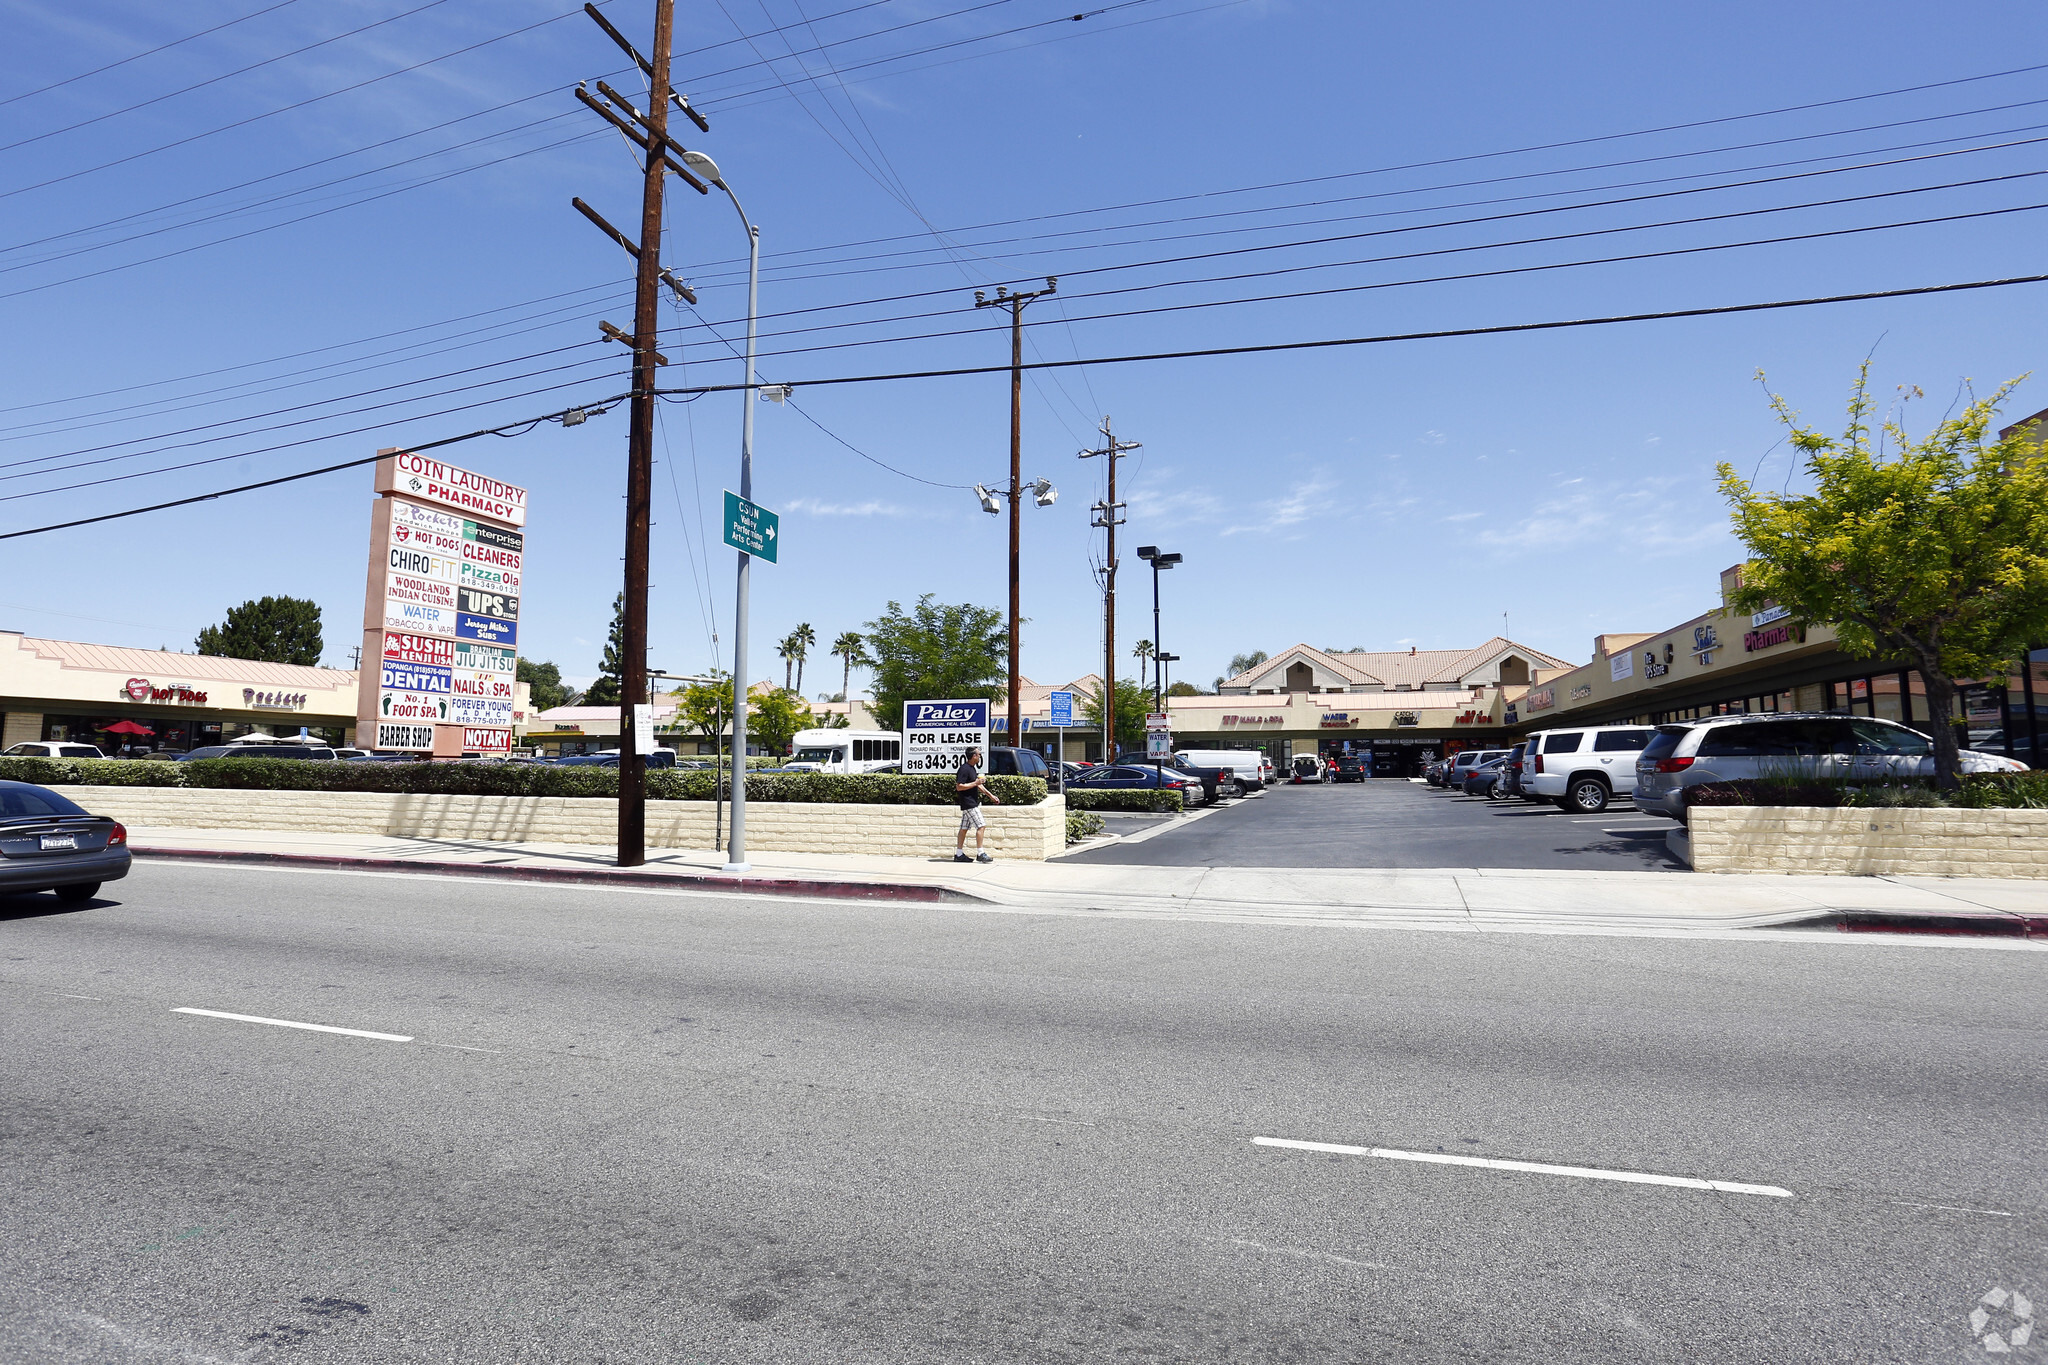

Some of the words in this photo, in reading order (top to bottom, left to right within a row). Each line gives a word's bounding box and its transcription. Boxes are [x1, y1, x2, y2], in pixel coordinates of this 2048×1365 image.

[399, 453, 443, 480] COIN
[450, 468, 524, 504] LAUNDRY
[428, 484, 514, 518] PHARMACY
[739, 502, 759, 519] CSUN
[740, 515, 757, 530] Valley
[415, 530, 432, 544] HOT
[436, 536, 460, 550] DOGS
[466, 526, 522, 546] enterprise
[732, 531, 744, 544] Arts
[746, 538, 764, 551] Center
[734, 522, 763, 543] Performing
[390, 548, 456, 578] CHIROFIT
[464, 544, 520, 568] CLEANERS
[462, 562, 501, 582] Pizza
[502, 572, 518, 586] Ola
[396, 576, 450, 596] WOODLANDS
[460, 577, 518, 595] 818-349-0133
[388, 586, 420, 600] INDIAN
[422, 593, 454, 607] CUISINE
[468, 590, 504, 616] UPS
[404, 604, 440, 621] WATER
[386, 616, 424, 630] TOBACCO
[428, 624, 434, 632] &
[438, 624, 454, 634] VAPE
[464, 618, 488, 632] Jersey
[401, 635, 453, 656] SUSHI
[470, 645, 502, 656] BRAZILIAN
[384, 662, 413, 672] TOPANGA
[401, 651, 432, 663] KENJI
[434, 656, 452, 666] USA
[457, 652, 476, 668] JIU
[480, 656, 514, 672] JITSU
[382, 670, 450, 692] DENTAL
[454, 679, 484, 695] NAILS
[486, 687, 492, 695] &
[493, 682, 510, 697] SPA
[152, 688, 174, 700] HOT
[179, 690, 208, 702] DOGS
[392, 704, 418, 717] FOOT
[420, 706, 437, 718] SPA
[452, 698, 486, 710] FOREVER
[488, 701, 512, 712] YOUNG
[917, 705, 976, 722] Paley
[456, 716, 506, 724] 818-775-0377
[380, 726, 410, 747] BARBER
[412, 727, 432, 748] SHOP
[466, 729, 510, 746] NOTARY
[910, 734, 935, 743] FOR
[941, 733, 981, 743] LEASE
[907, 760, 923, 769] 818
[925, 755, 983, 769] 343-300
